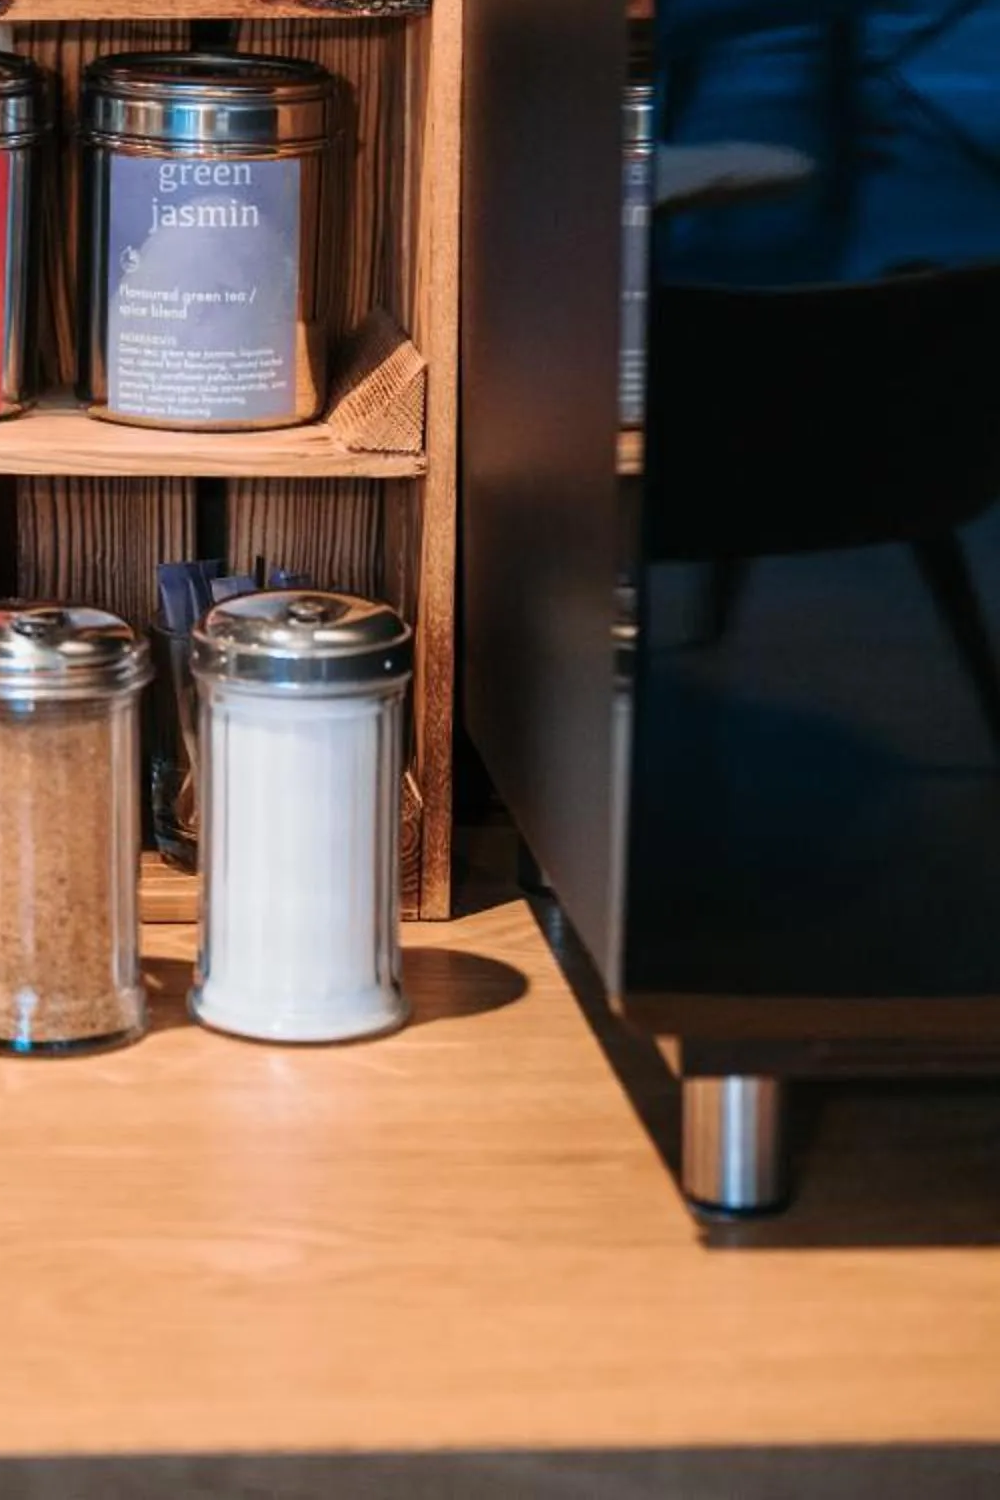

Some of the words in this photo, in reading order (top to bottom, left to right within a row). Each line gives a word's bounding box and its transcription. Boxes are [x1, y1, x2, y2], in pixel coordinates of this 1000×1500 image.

[159, 162, 252, 192] green
[150, 197, 259, 234] jasmin
[183, 289, 222, 304] green
[225, 290, 245, 303] tea
[151, 304, 187, 319] blend
